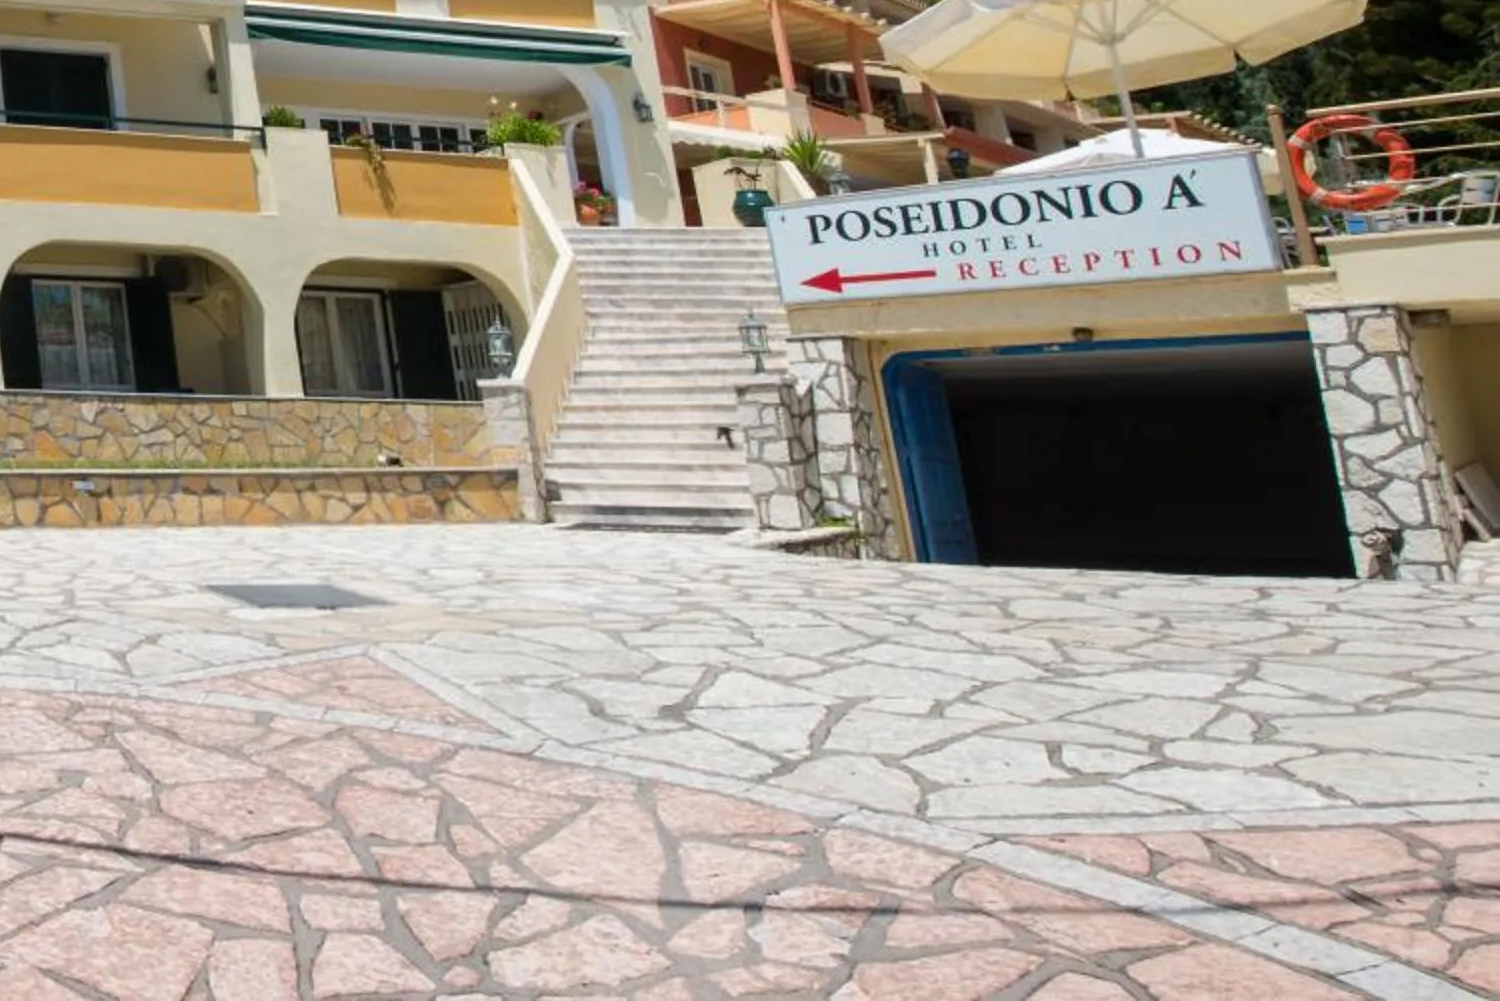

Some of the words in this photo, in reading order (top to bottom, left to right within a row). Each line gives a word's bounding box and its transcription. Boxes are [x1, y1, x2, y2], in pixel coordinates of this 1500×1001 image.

[805, 179, 1143, 245] POSEIDONIO
[922, 233, 1043, 258] HOTEL
[957, 239, 1244, 281] RECEPTION
